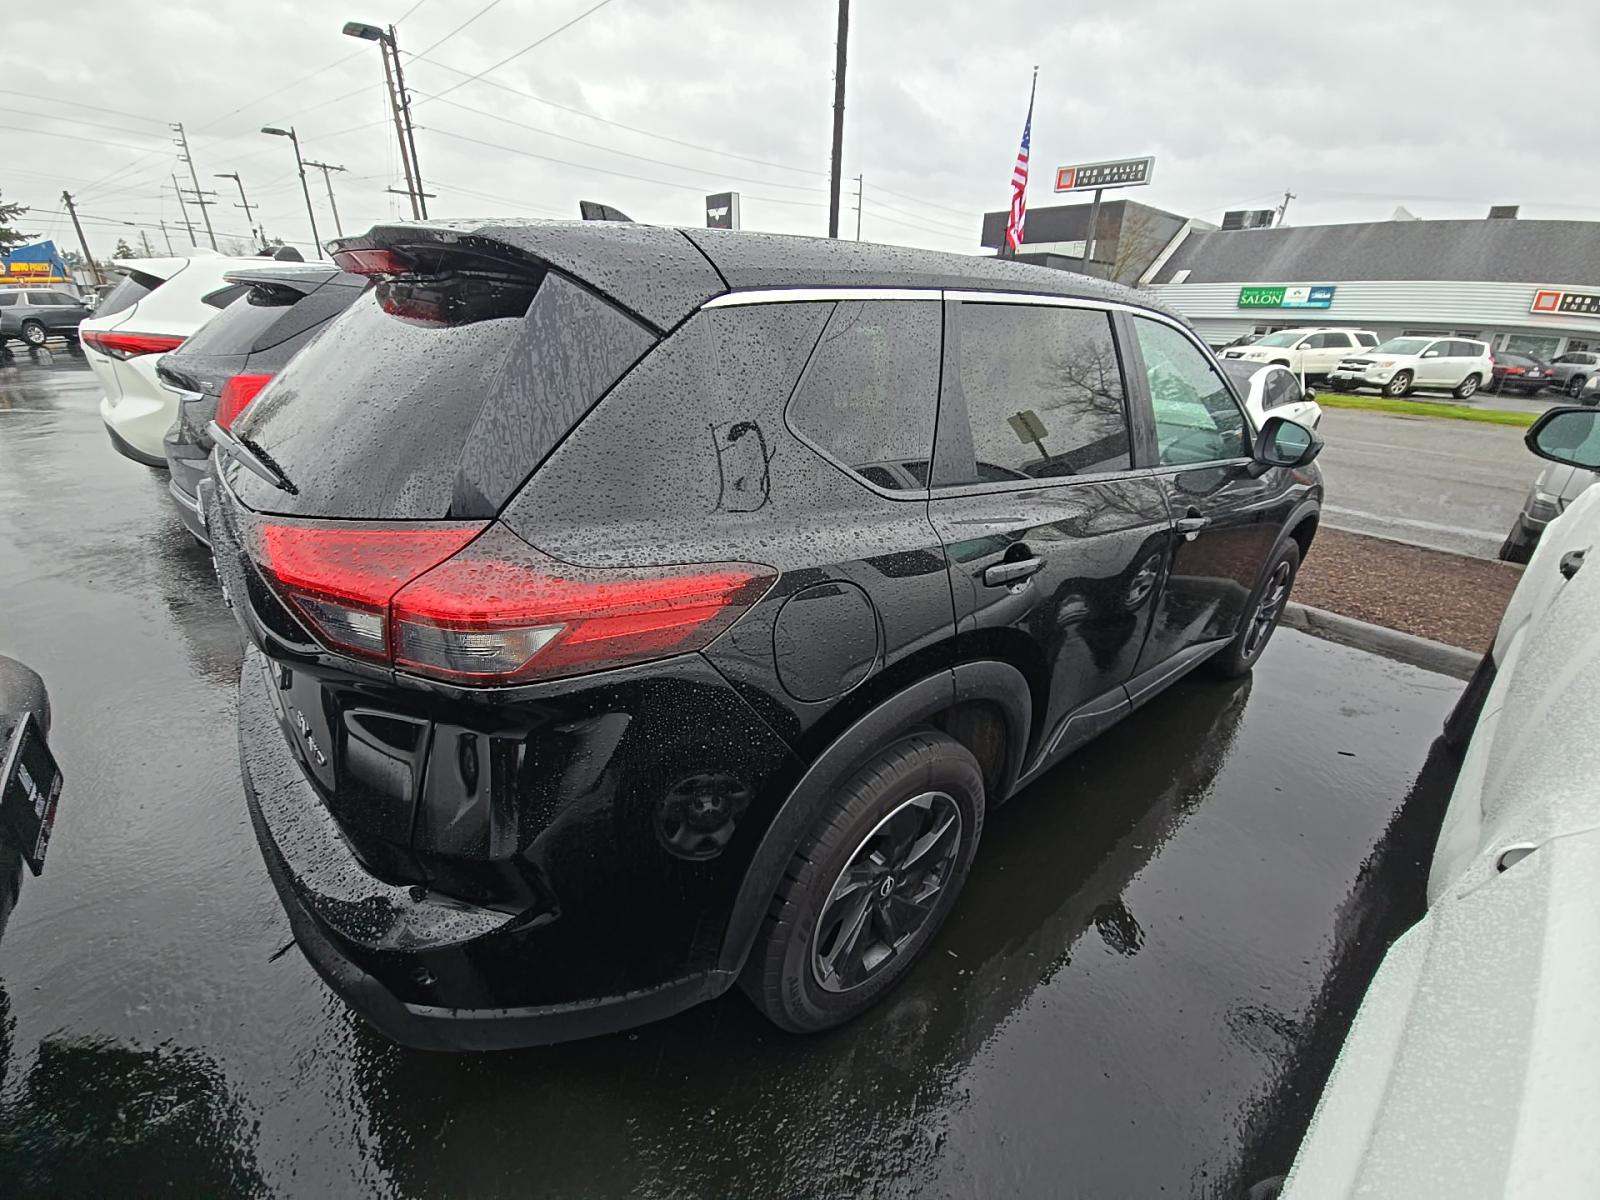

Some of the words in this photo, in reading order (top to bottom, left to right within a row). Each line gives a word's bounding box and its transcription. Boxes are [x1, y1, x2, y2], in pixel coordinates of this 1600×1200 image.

[1104, 164, 1144, 174] WALLIN
[1077, 172, 1142, 184] INSURANCE
[1240, 294, 1283, 305] SALON
